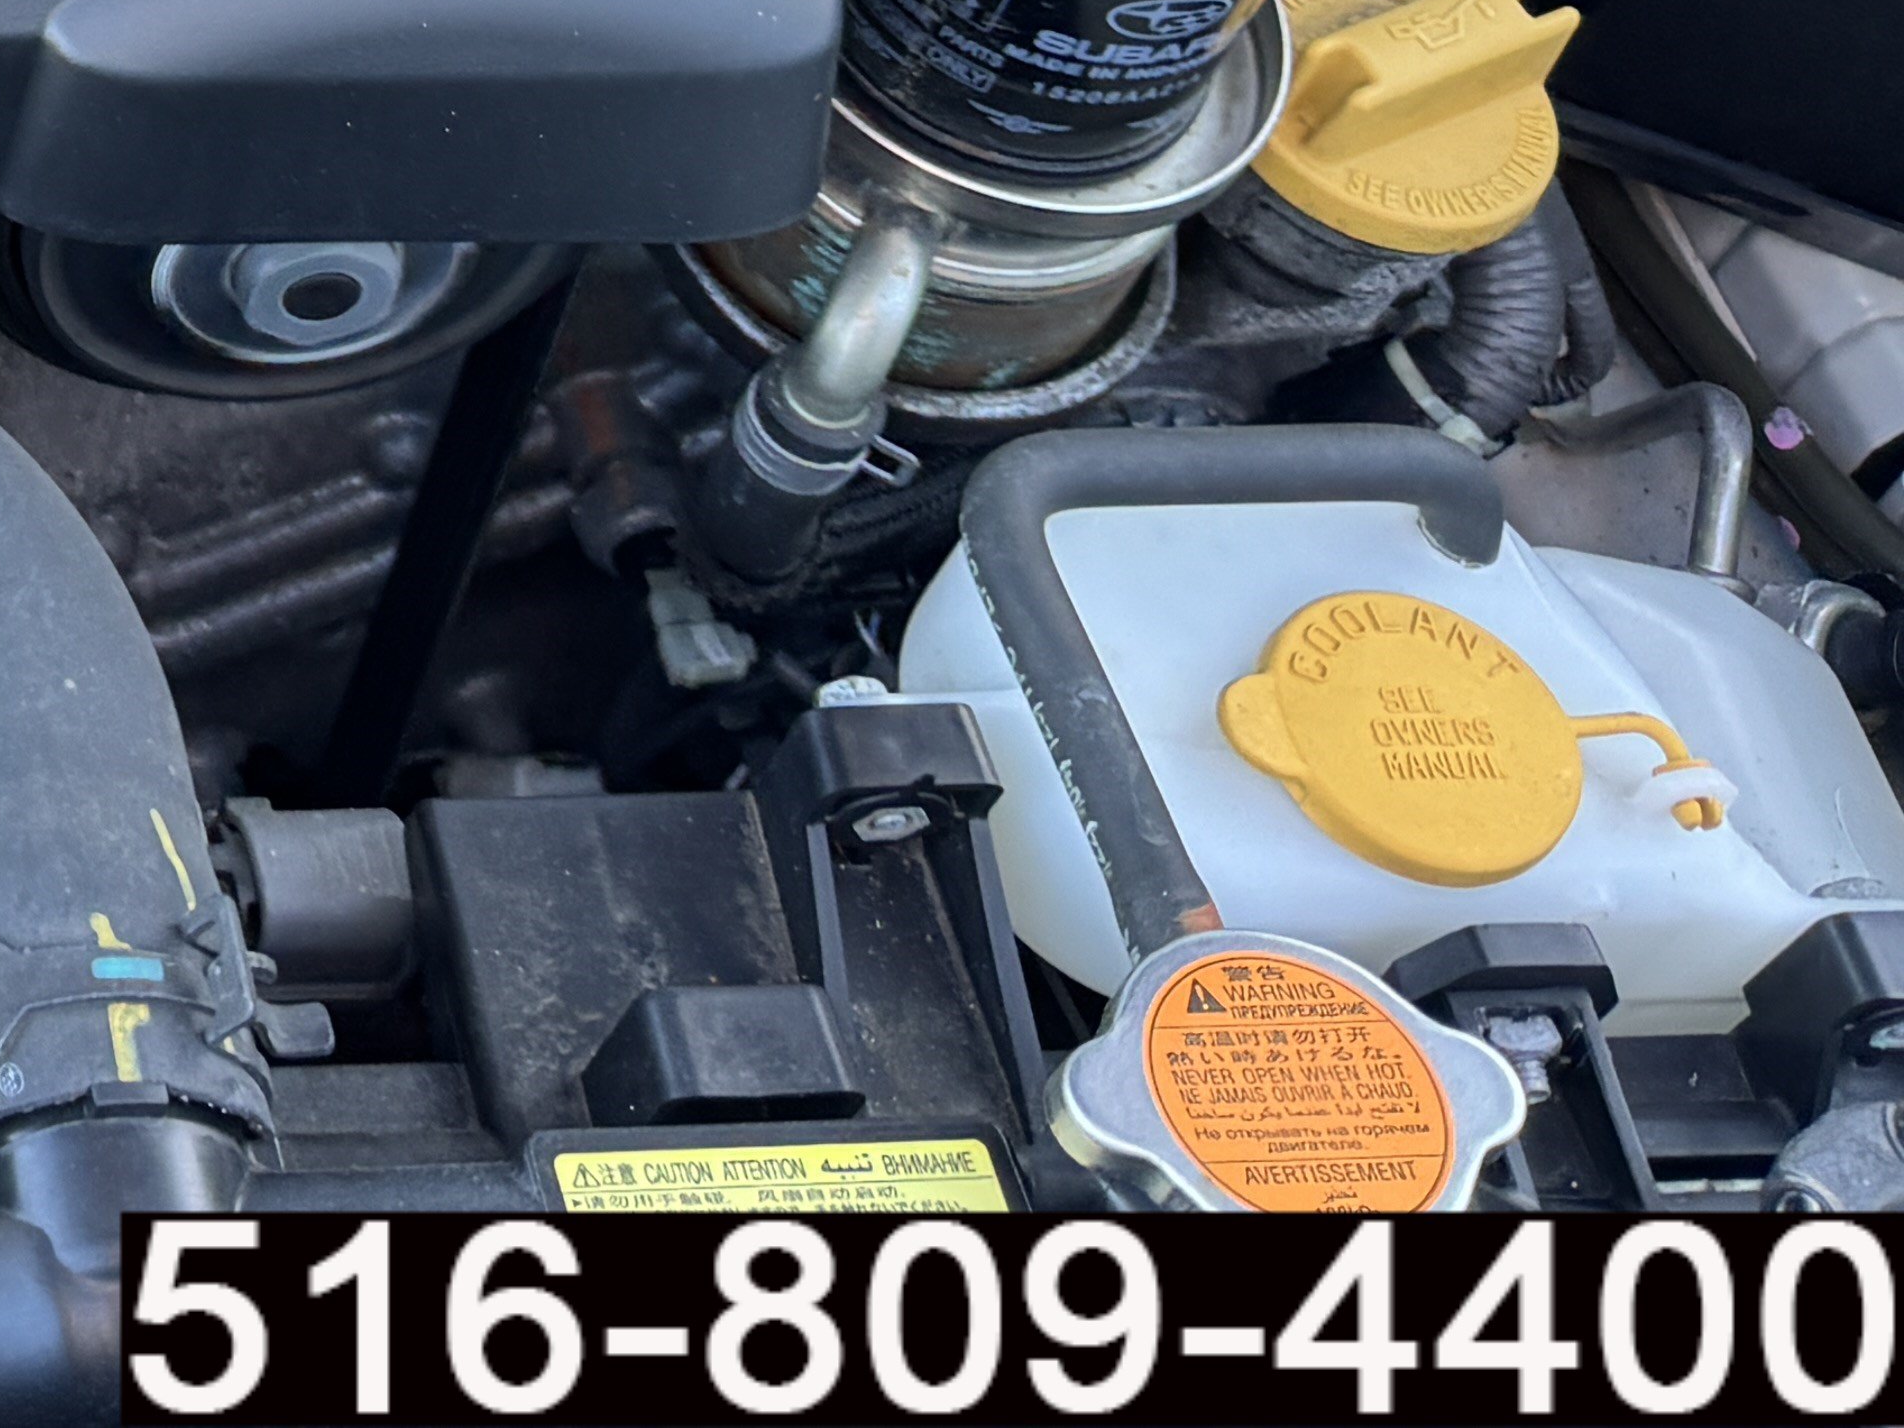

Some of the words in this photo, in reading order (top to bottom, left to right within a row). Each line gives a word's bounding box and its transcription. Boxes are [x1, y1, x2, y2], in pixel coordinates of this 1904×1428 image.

[1002, 43, 1085, 77] MADE
[1088, 66, 1121, 80] IN
[1347, 172, 1403, 209] SEE
[1501, 106, 1553, 190] MANUAL
[1289, 600, 1523, 684] COOLANT
[1378, 685, 1444, 715] SEE
[1370, 717, 1495, 748] OWNERS
[1381, 751, 1511, 782] MANUAL
[1222, 965, 1286, 982] 警告
[1223, 982, 1336, 1003] WARNING
[1230, 1001, 1370, 1021] ПРЕДУПРЕЖДЕНИЕ
[1171, 1068, 1235, 1087] NEVER
[1242, 1066, 1295, 1084] OPEN
[1300, 1064, 1357, 1083] WHEN
[1179, 1088, 1202, 1105] NE
[1208, 1087, 1268, 1104] JAMAIS
[1272, 1084, 1337, 1103] OUVRIR
[1195, 1127, 1222, 1141] Не
[1226, 1125, 1322, 1142] открывать
[1326, 1125, 1350, 1137] на
[598, 1164, 636, 1186] 注意
[643, 1160, 714, 1185] CAUTION
[723, 1157, 809, 1182] ATTENTION
[820, 1153, 874, 1183] تنبيه
[882, 1150, 977, 1175] ВНИМАНИЕ
[1244, 1160, 1418, 1186] AVERTISSEMENT
